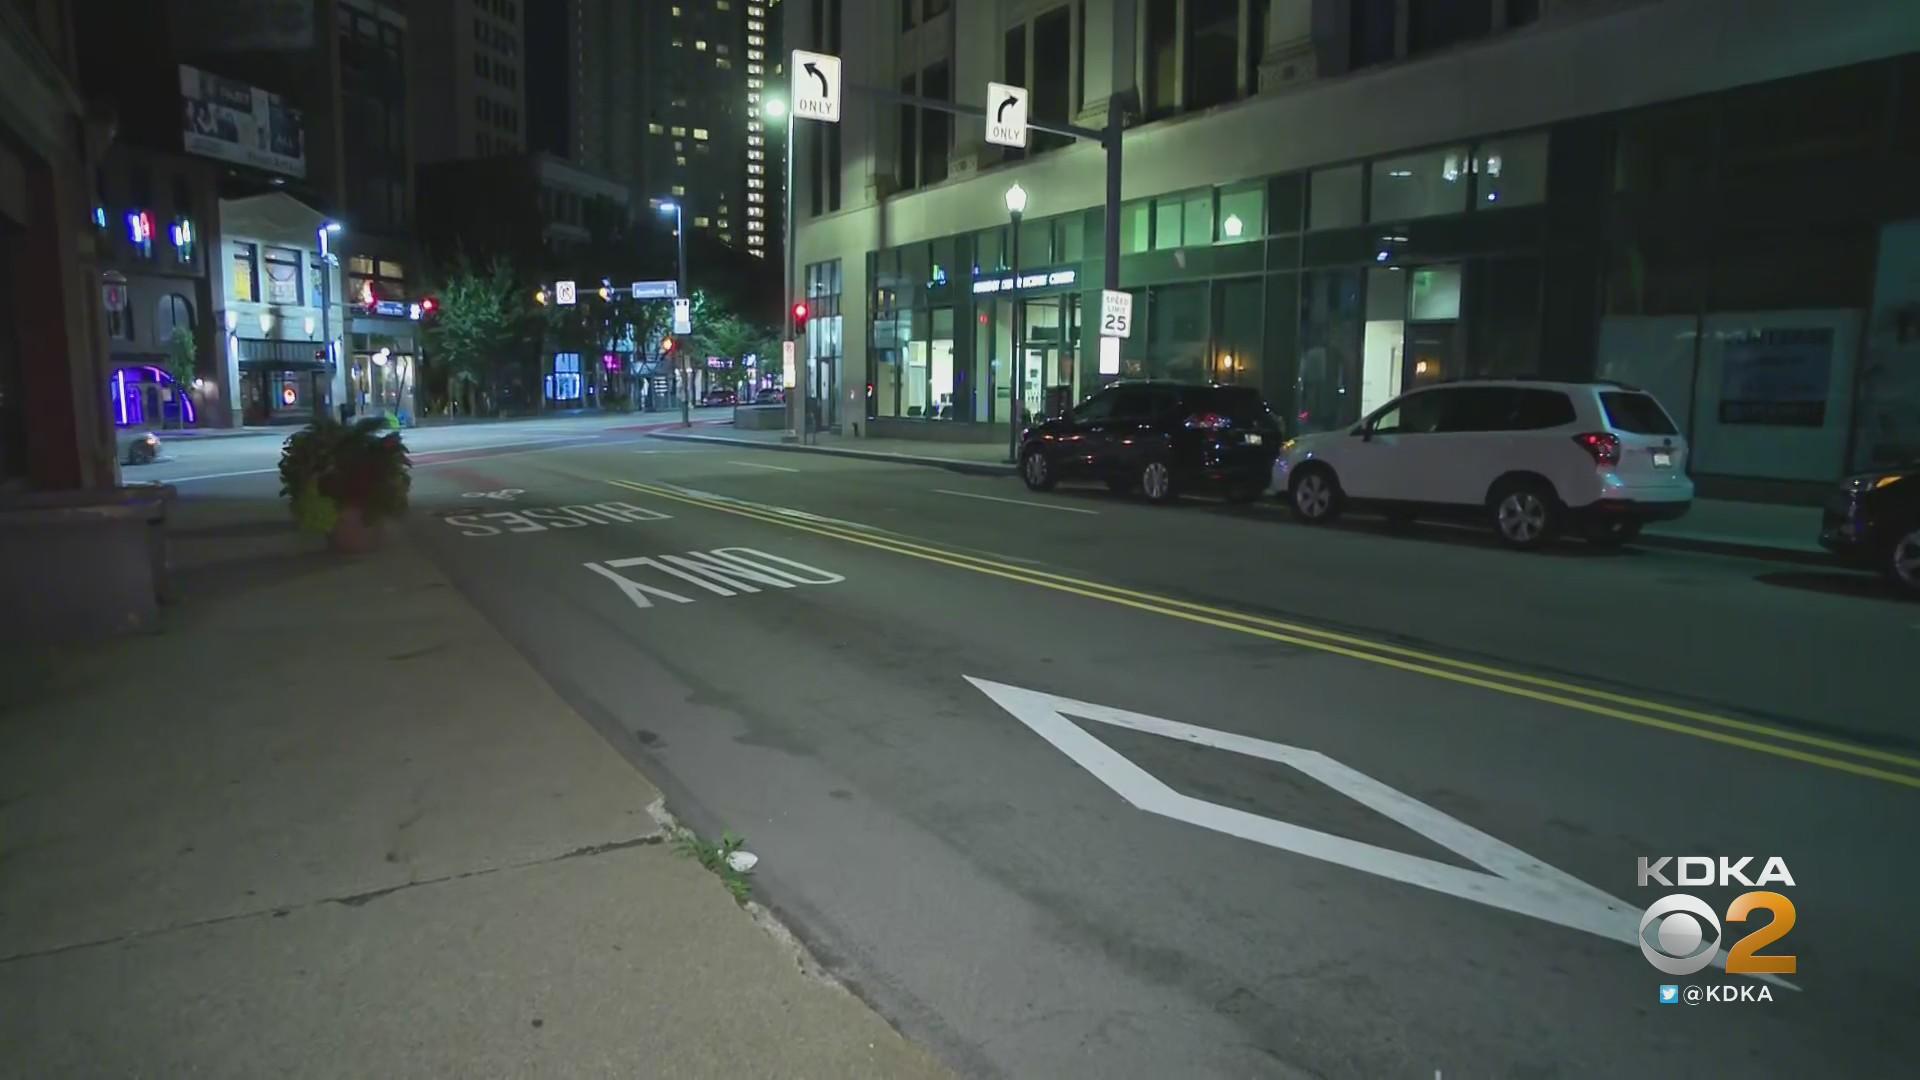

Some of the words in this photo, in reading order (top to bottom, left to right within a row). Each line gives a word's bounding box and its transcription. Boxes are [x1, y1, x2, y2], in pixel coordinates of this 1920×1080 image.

[799, 98, 833, 116] ONLY
[992, 125, 1021, 140] ONLY
[1106, 295, 1129, 306] SPEED
[1107, 305, 1126, 314] LIMIT
[1104, 313, 1127, 331] 25
[444, 502, 673, 537] BUSES
[583, 546, 846, 609] ONLY
